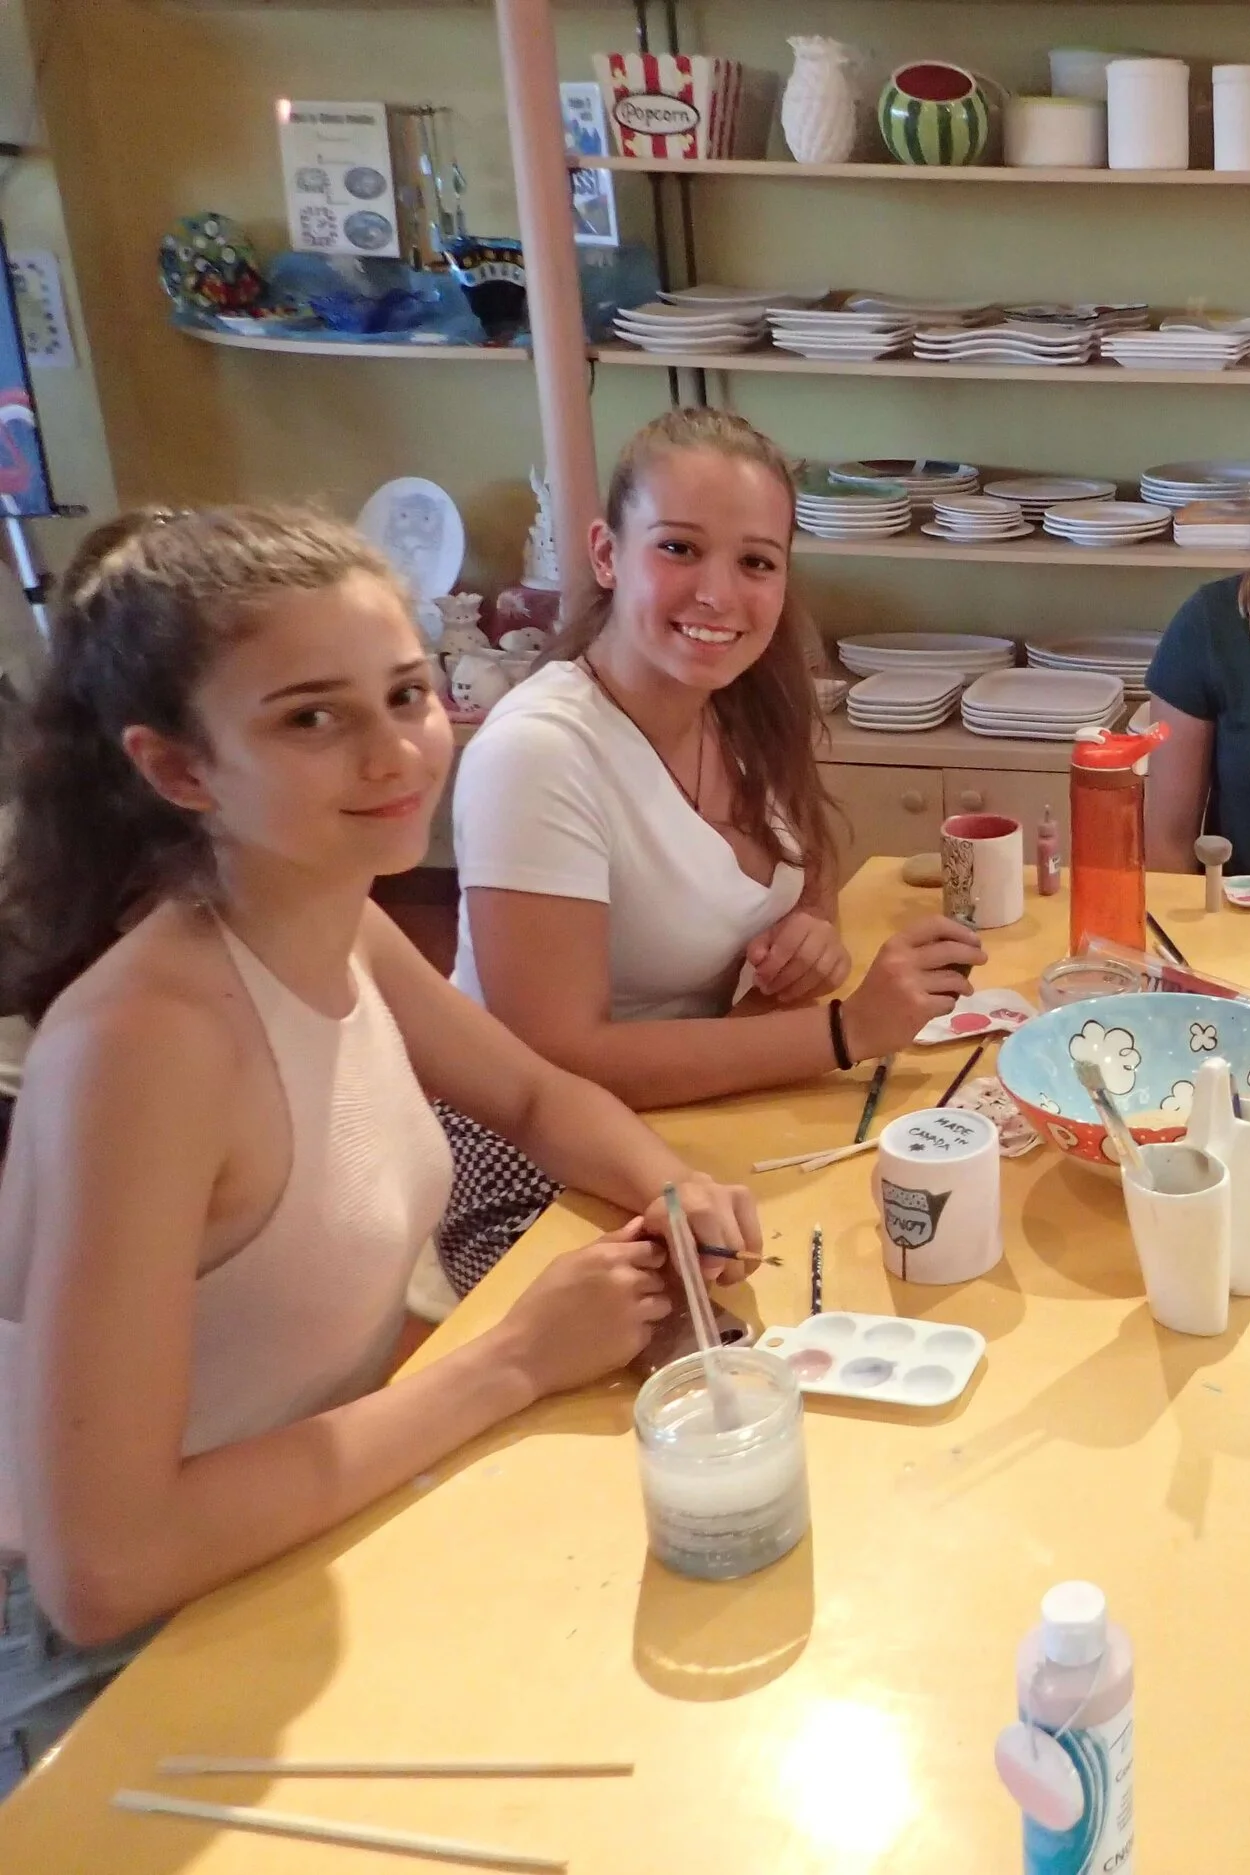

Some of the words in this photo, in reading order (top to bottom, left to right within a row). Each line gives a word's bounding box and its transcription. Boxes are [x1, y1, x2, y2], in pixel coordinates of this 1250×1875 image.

[621, 101, 692, 127] Popcorn
[933, 1117, 976, 1136] MADE
[908, 1127, 951, 1151] CANADA
